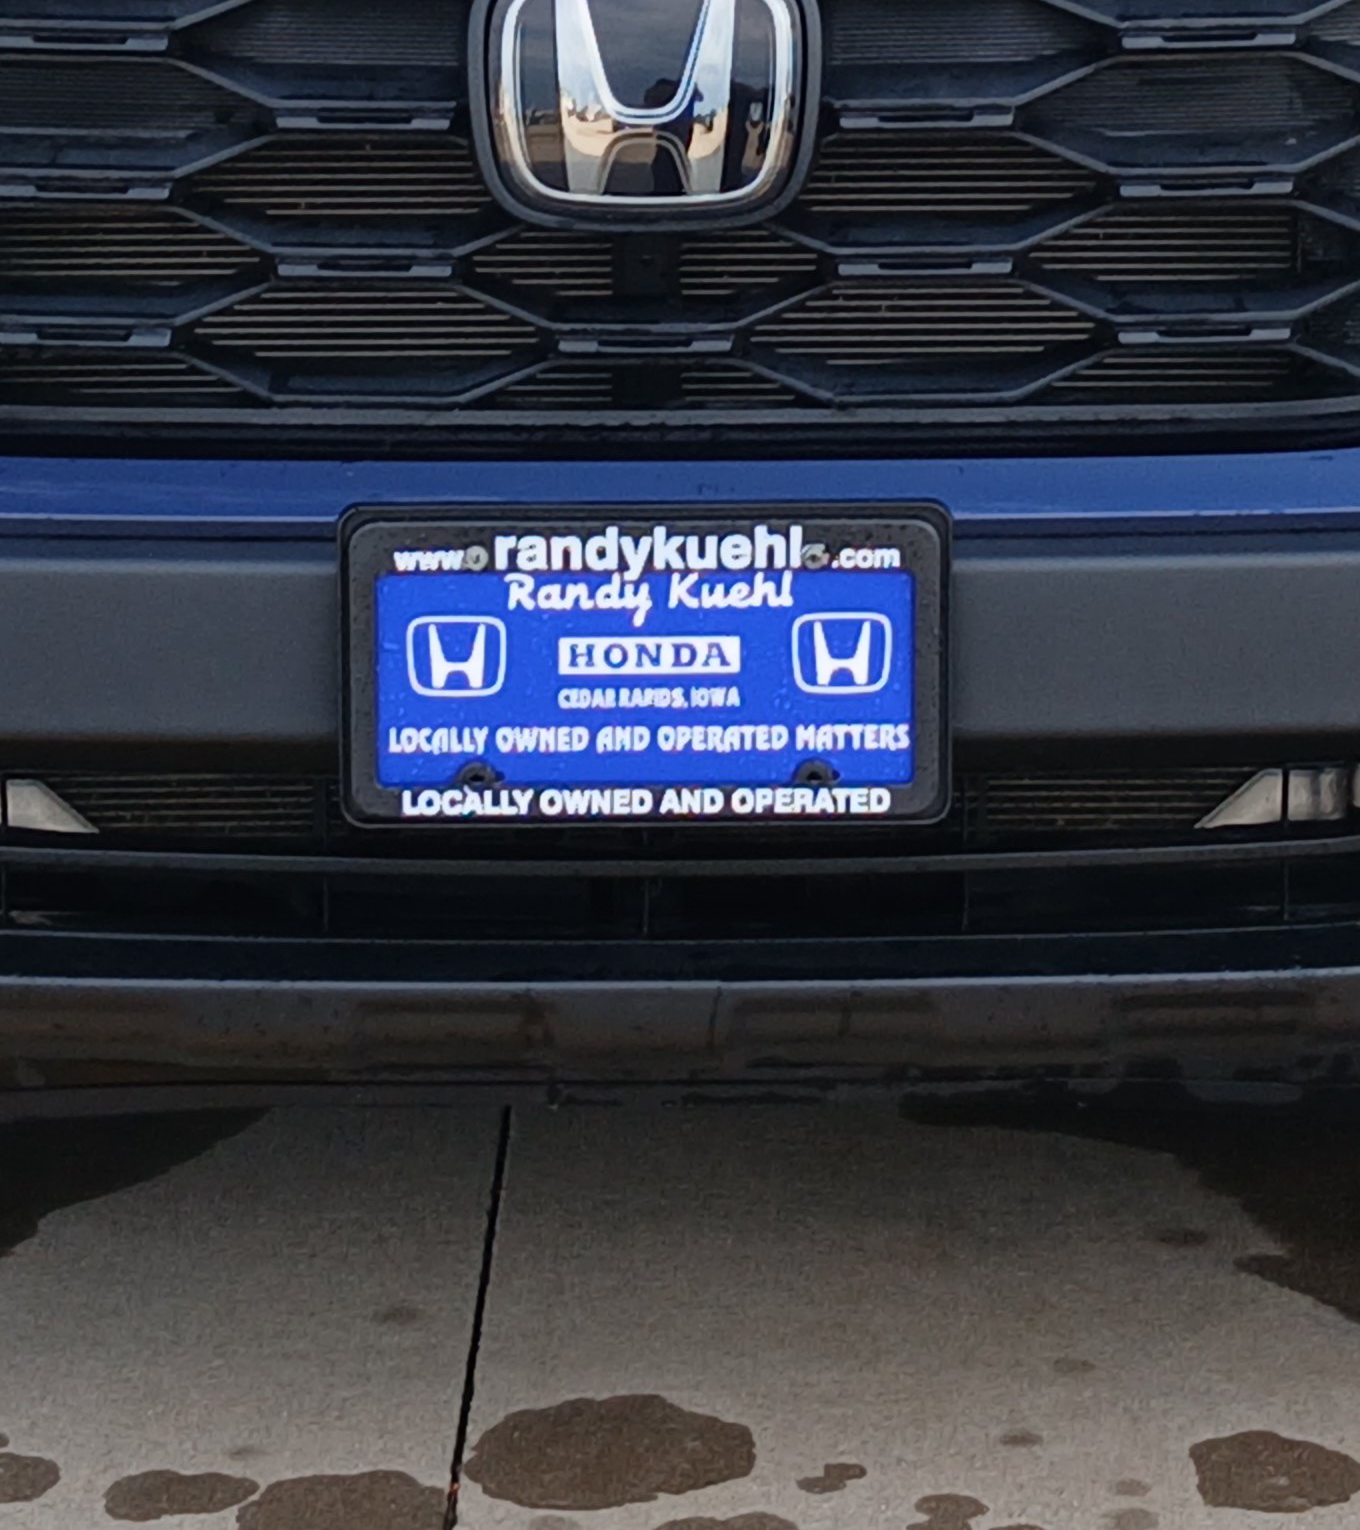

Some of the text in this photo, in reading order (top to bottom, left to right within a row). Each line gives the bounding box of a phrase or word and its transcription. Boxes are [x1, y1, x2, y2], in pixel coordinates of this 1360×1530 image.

[494, 525, 803, 581] randykuehl
[504, 570, 794, 628] Randy Kuehl
[568, 642, 731, 669] HONDA
[558, 687, 616, 709] CEDAR
[691, 685, 741, 708] IOWA
[388, 723, 910, 755] LOCALLY OWNED AND OPERATED MATTERS
[402, 787, 891, 817] LOCALLY OWNED AND OPERATED
